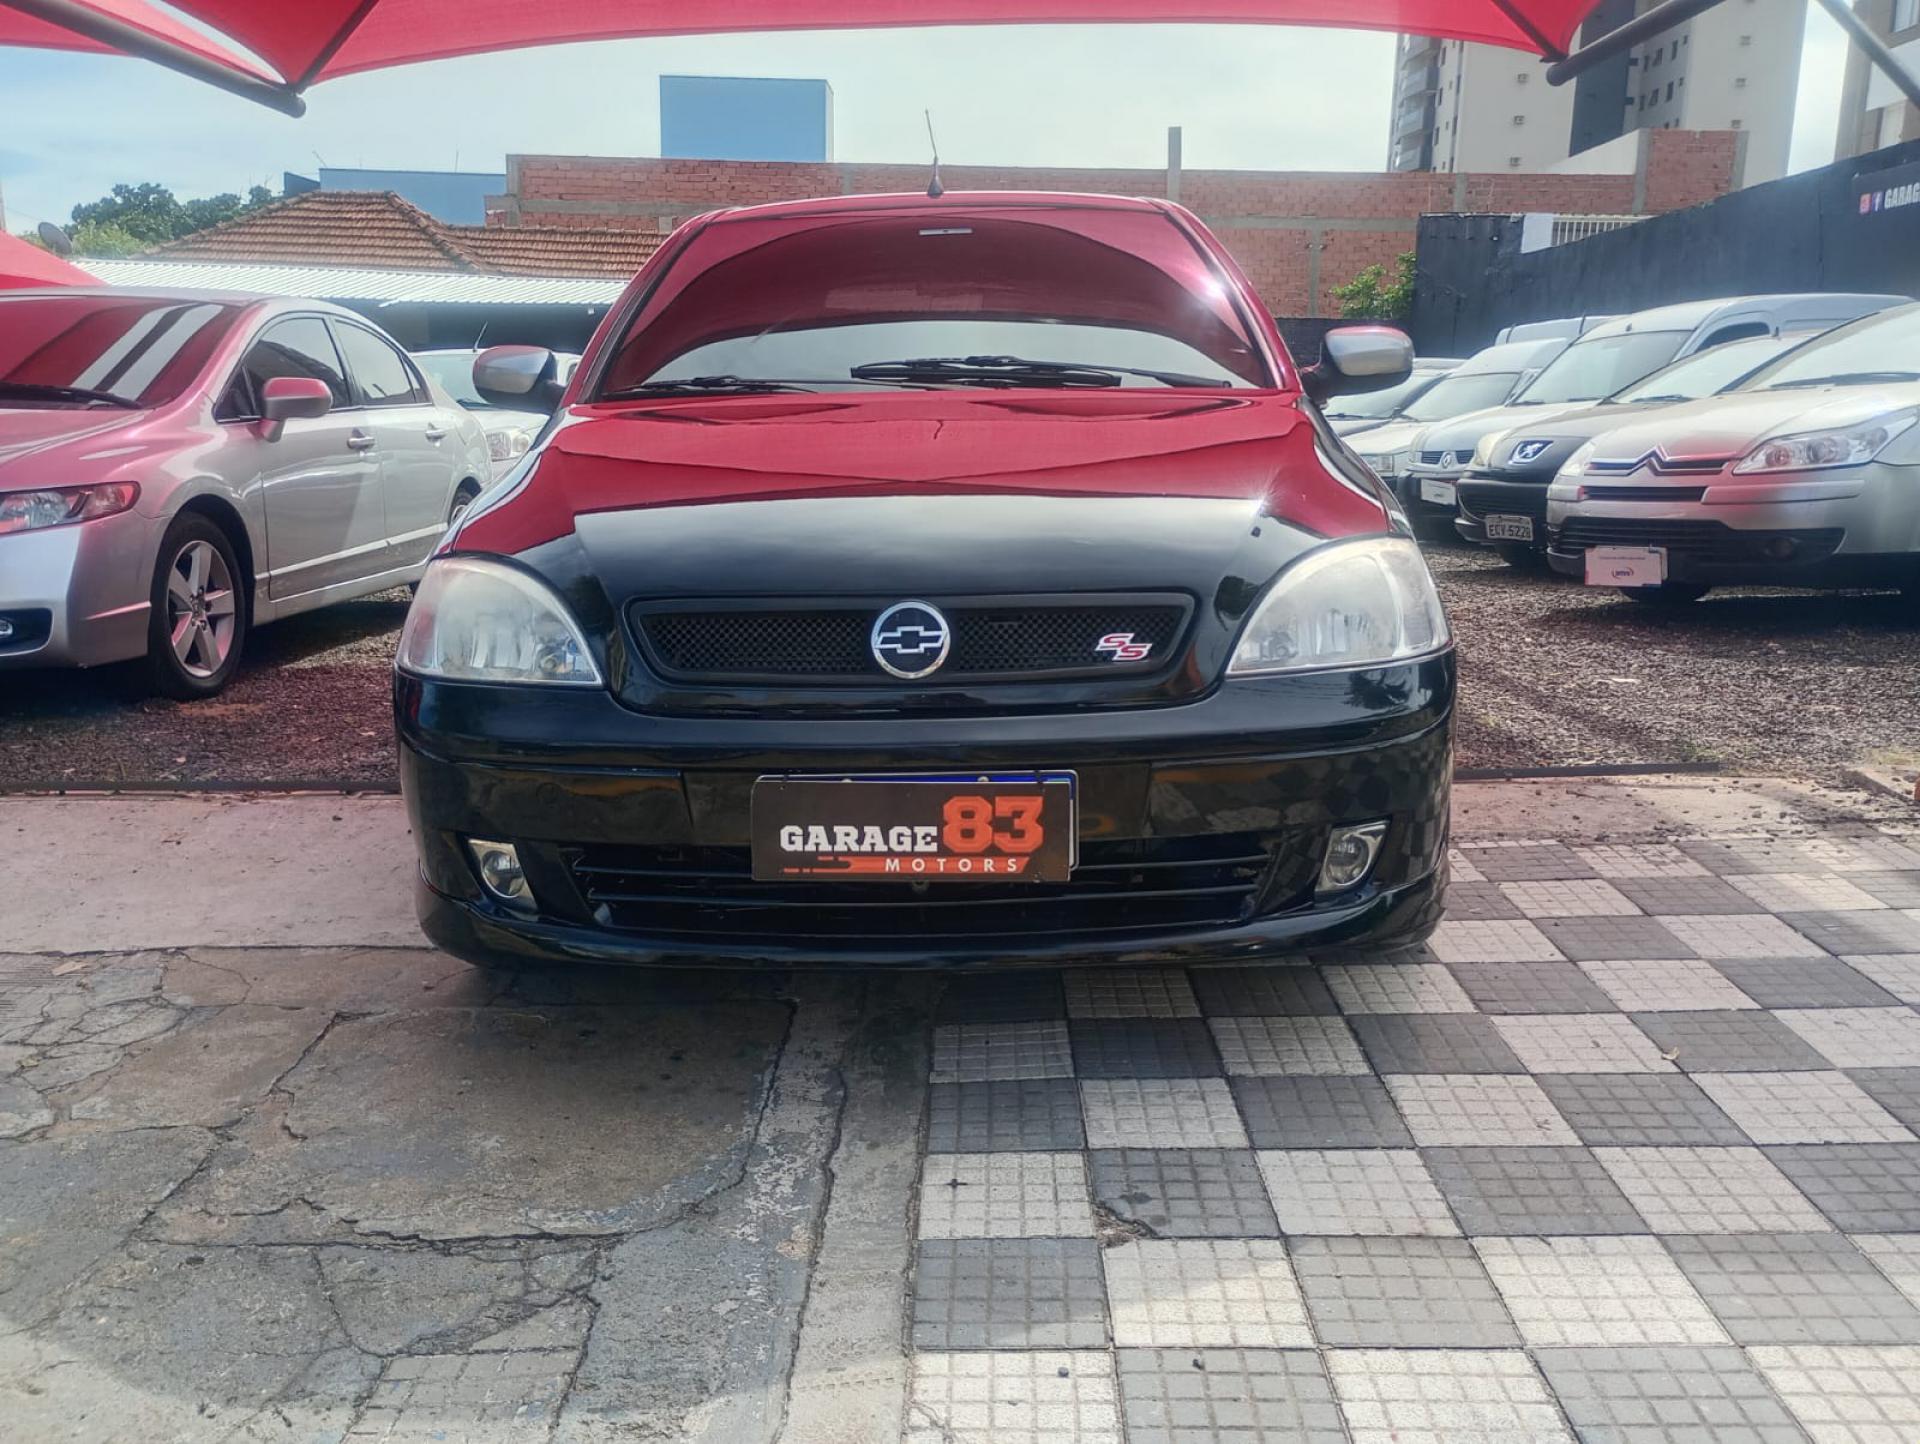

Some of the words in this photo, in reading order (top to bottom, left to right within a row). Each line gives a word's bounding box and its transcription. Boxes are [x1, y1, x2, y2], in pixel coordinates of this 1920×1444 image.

[1094, 633, 1152, 661] SS
[780, 825, 938, 852] GARAGE
[943, 795, 1044, 853] 83
[885, 857, 1018, 872] MOTORS
